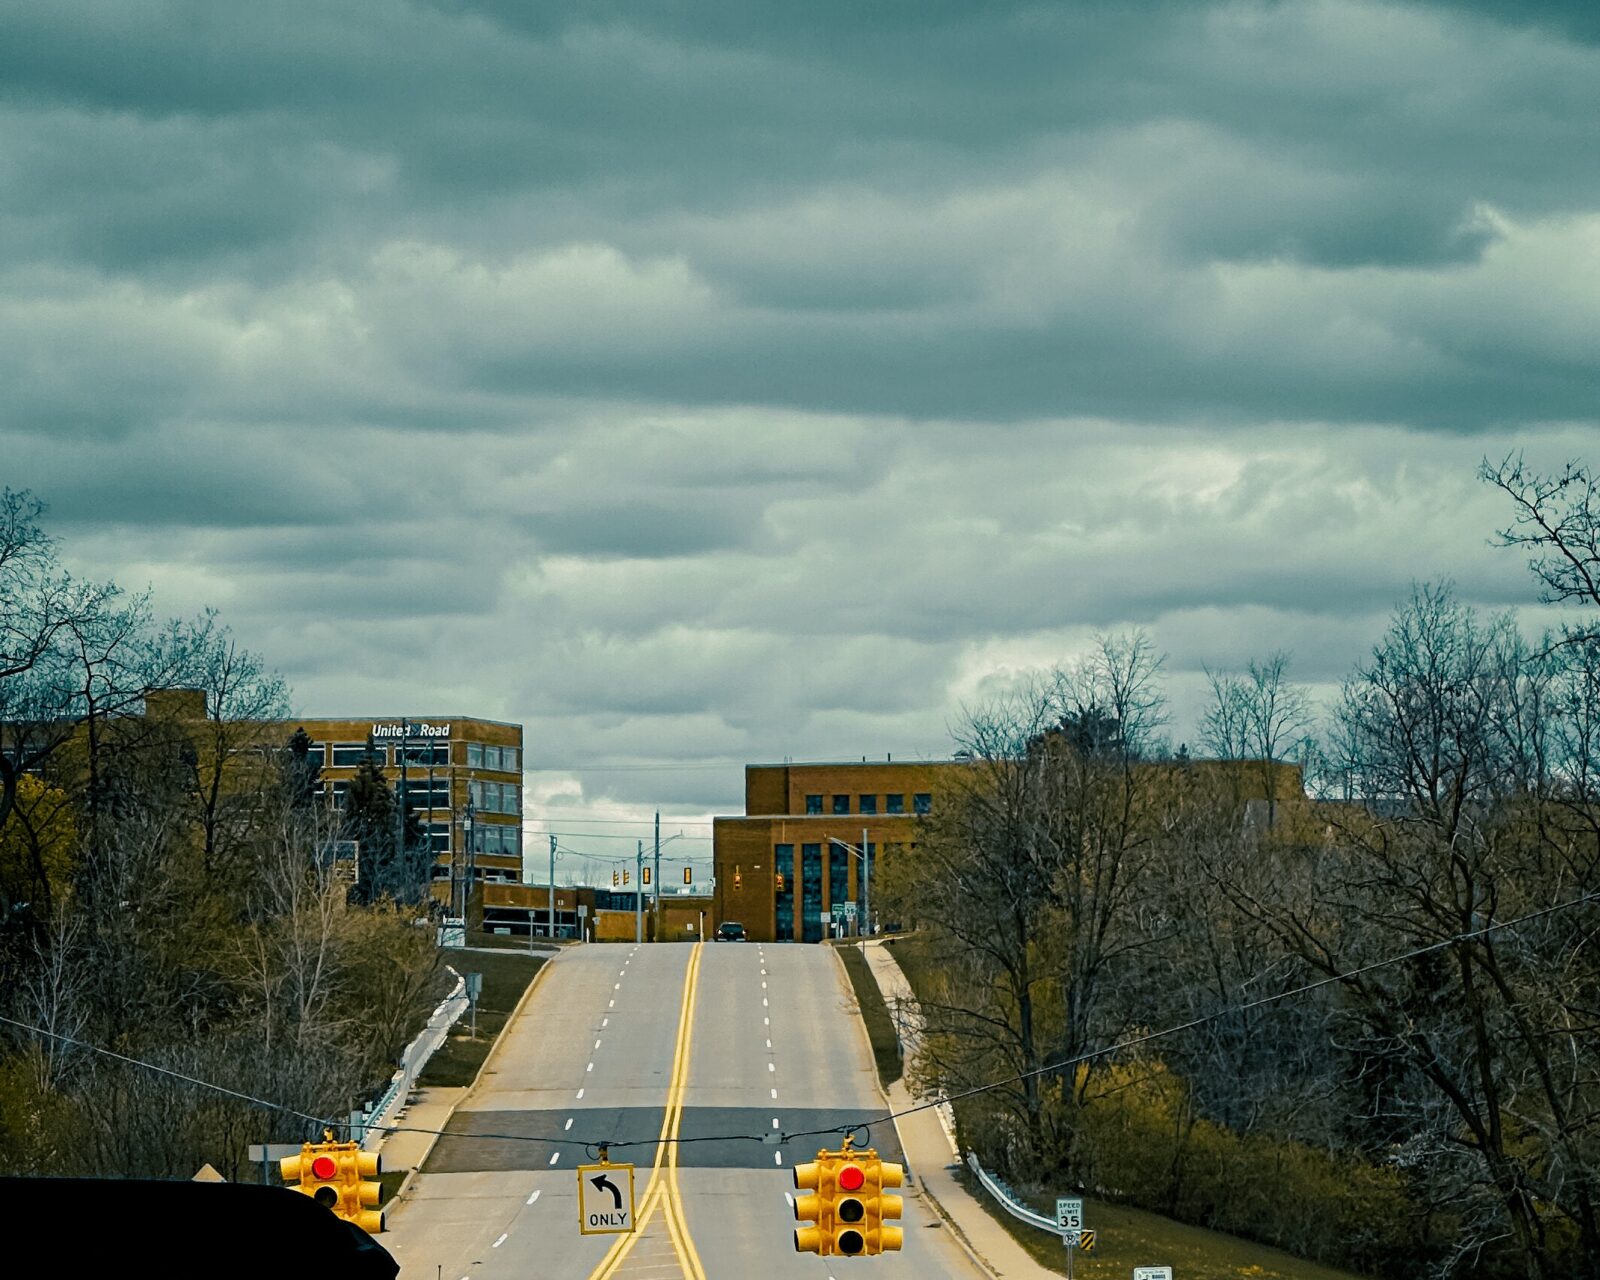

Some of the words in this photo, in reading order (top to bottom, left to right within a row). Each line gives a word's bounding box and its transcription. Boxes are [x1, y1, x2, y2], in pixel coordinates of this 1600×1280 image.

[372, 723, 411, 737] United
[420, 723, 450, 737] Road
[590, 1213, 627, 1226] ONLY
[1060, 1216, 1079, 1227] 35
